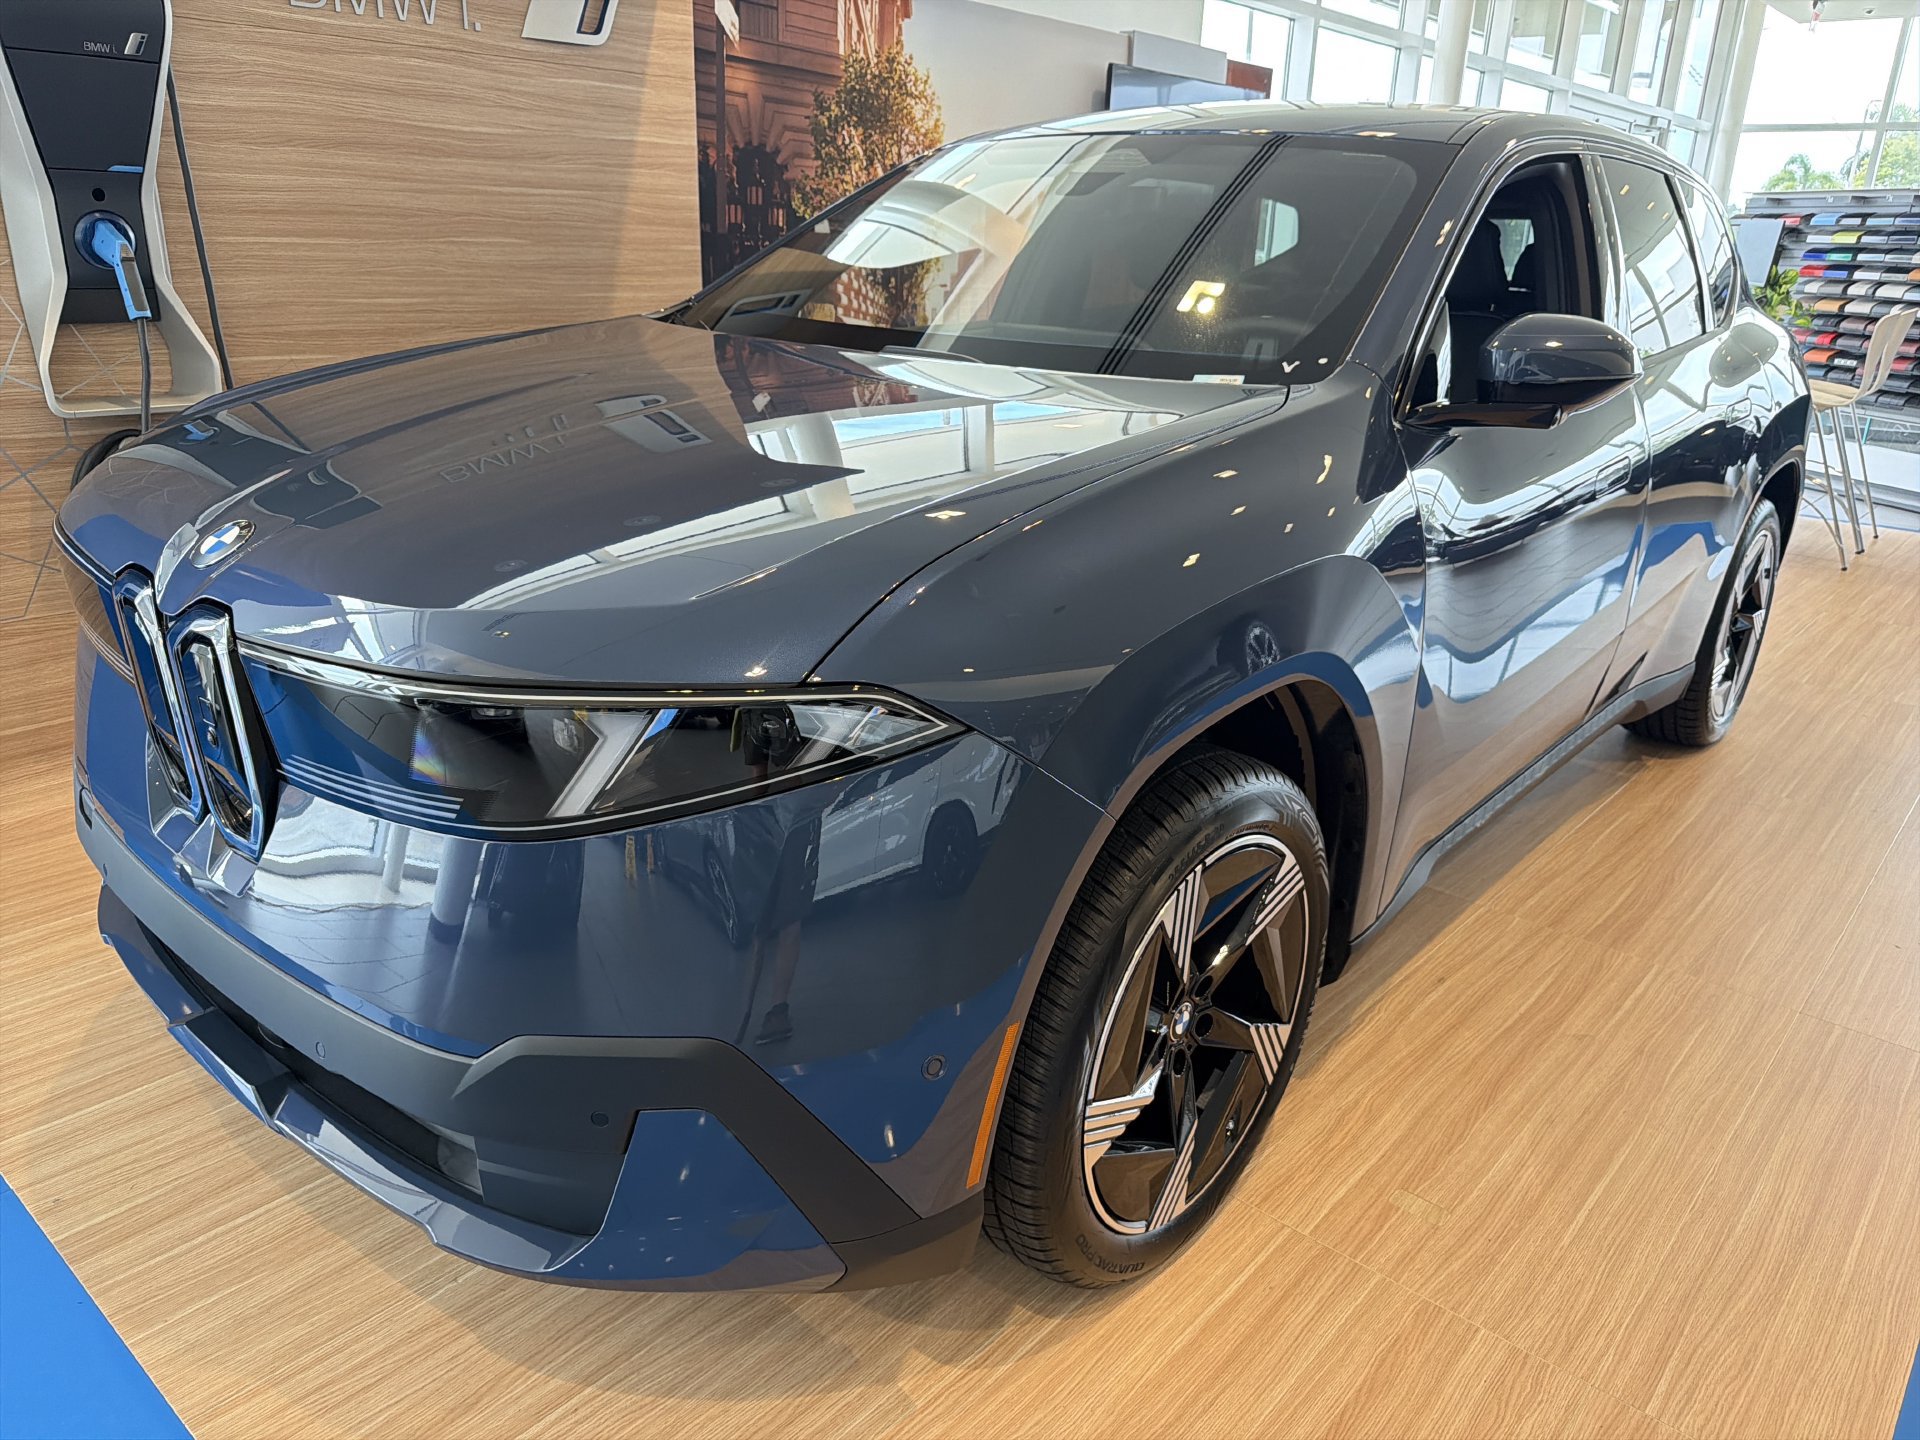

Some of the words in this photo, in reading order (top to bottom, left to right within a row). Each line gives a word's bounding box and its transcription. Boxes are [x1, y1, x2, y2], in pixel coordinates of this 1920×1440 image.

[83, 41, 111, 53] BMW
[1075, 1234, 1096, 1262] PRO
[1094, 1256, 1146, 1274] QUATRAC
